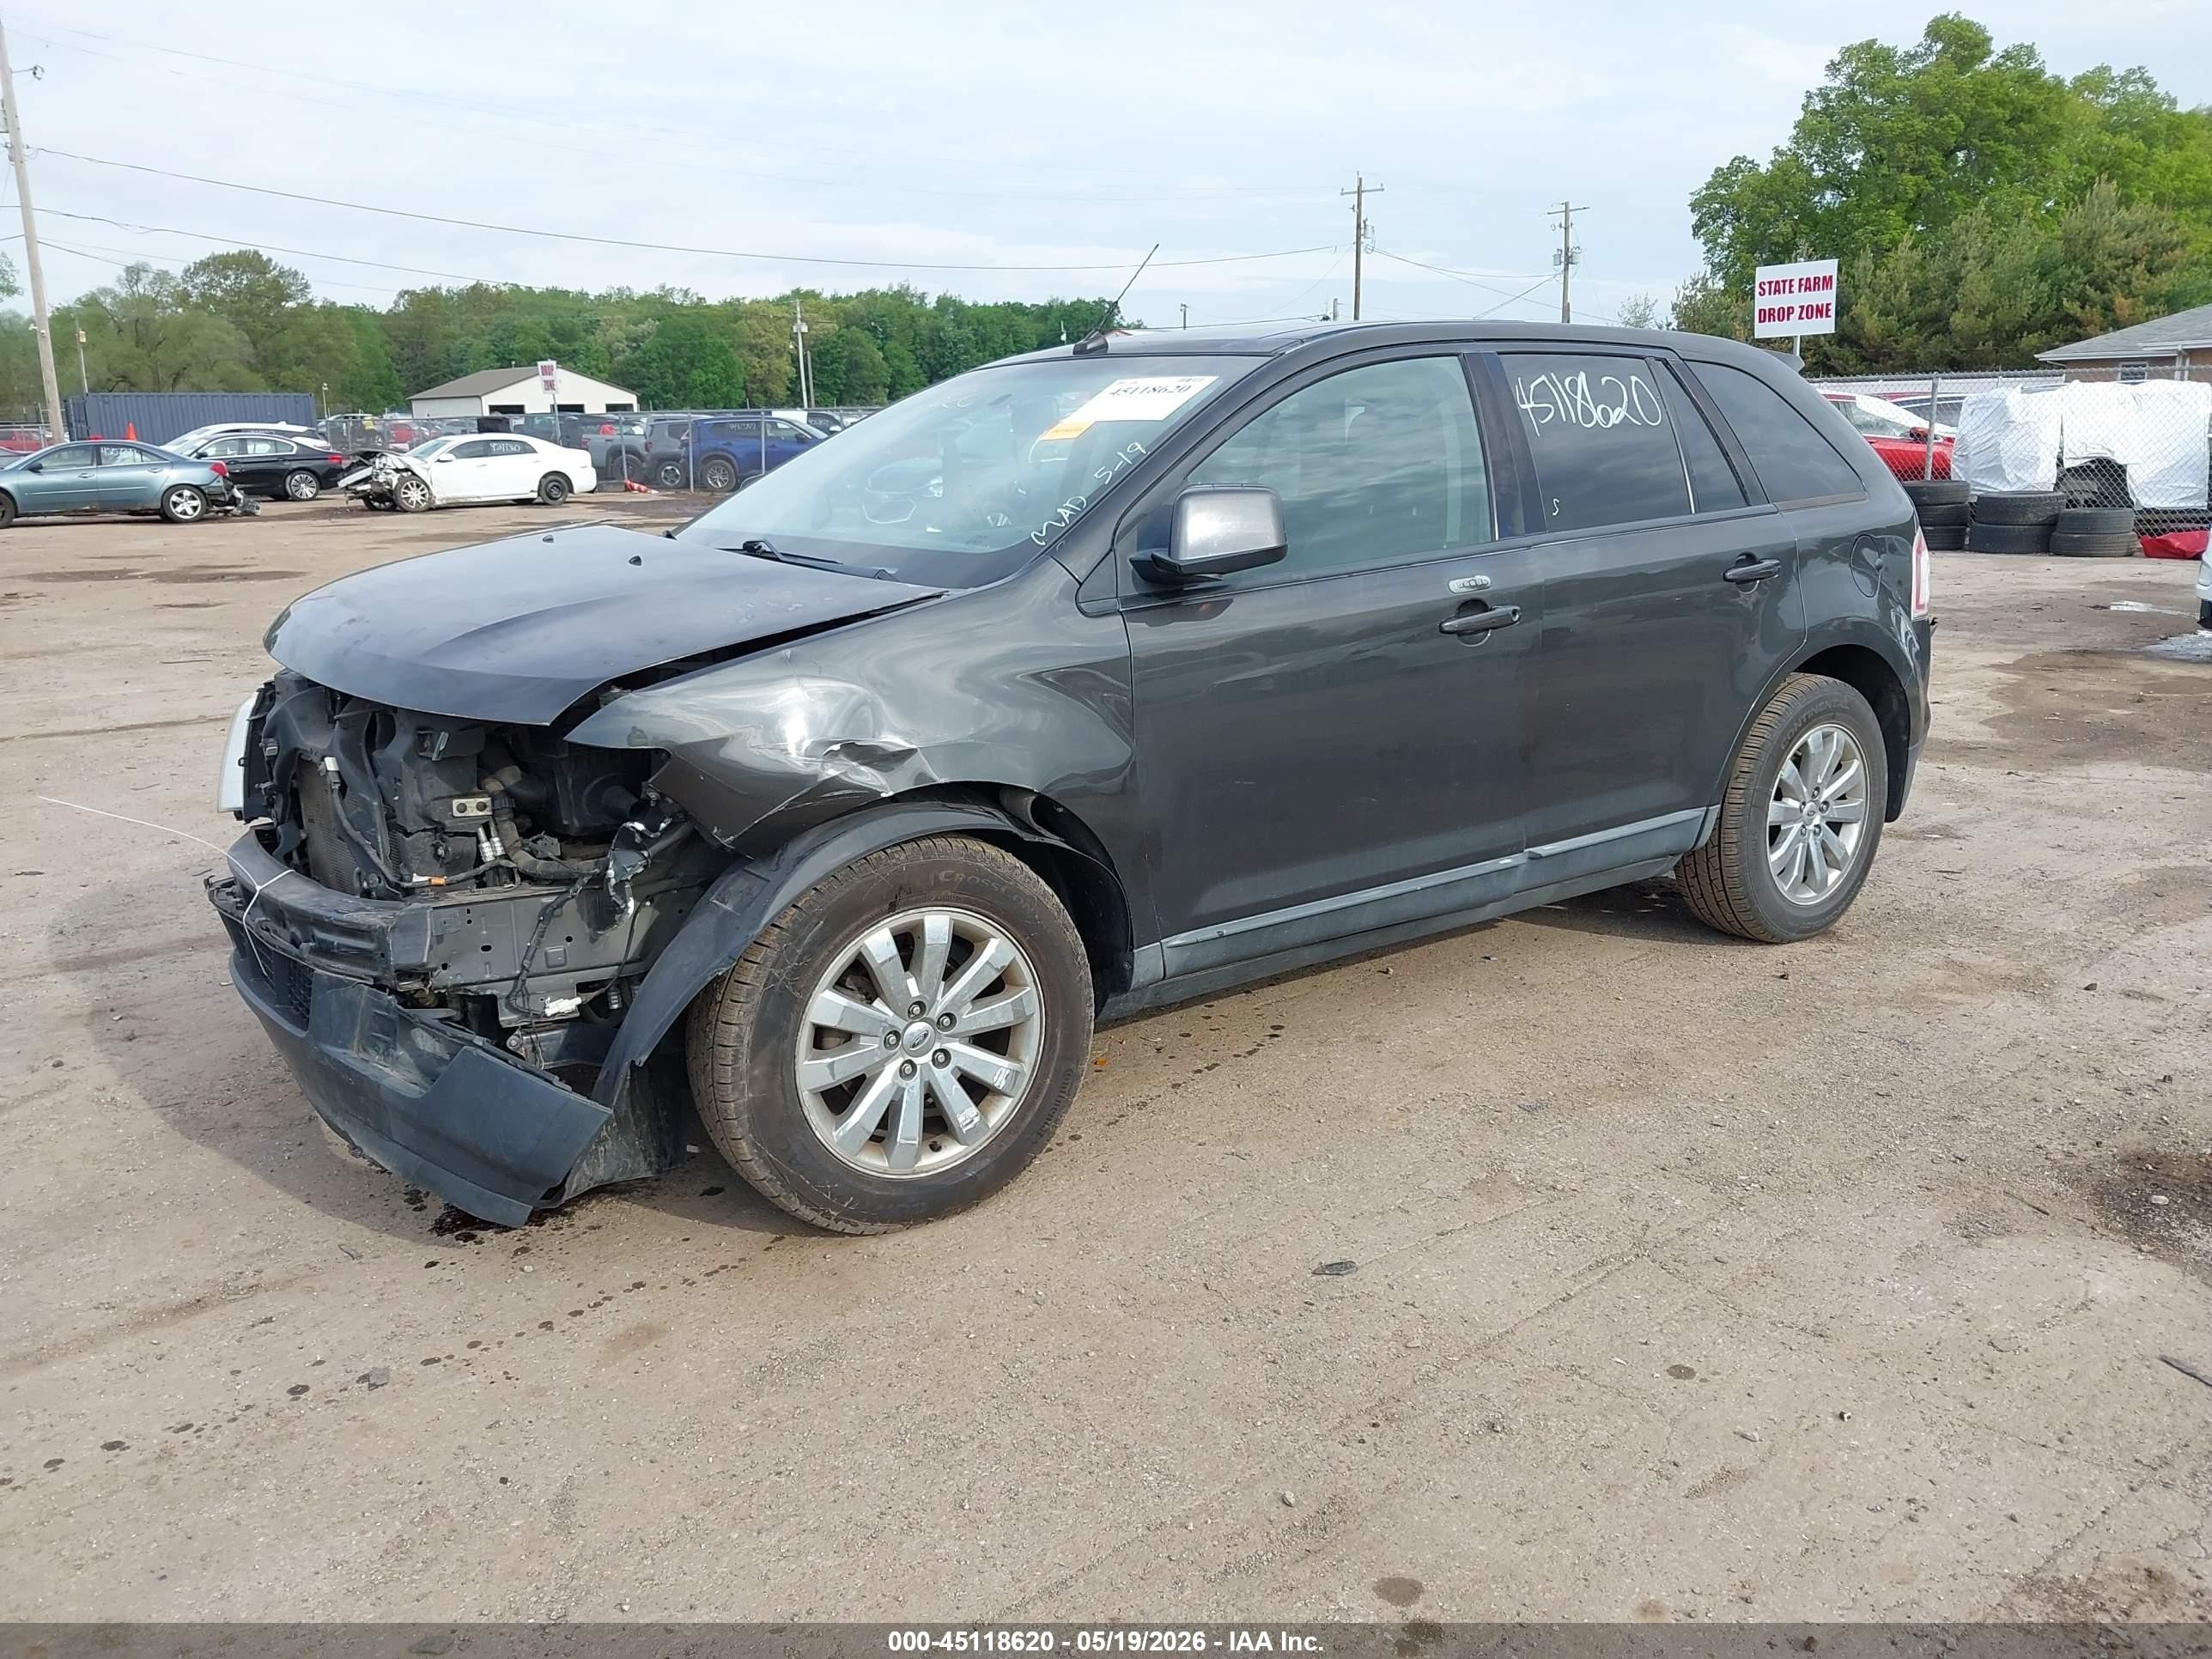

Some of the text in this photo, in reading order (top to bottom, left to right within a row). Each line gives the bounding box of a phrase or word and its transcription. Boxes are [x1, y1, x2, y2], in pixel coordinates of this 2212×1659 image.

[1758, 274, 1833, 297] STATE FARM
[1758, 302, 1832, 324] DROP ZONE
[1030, 495, 1087, 546] MAD
